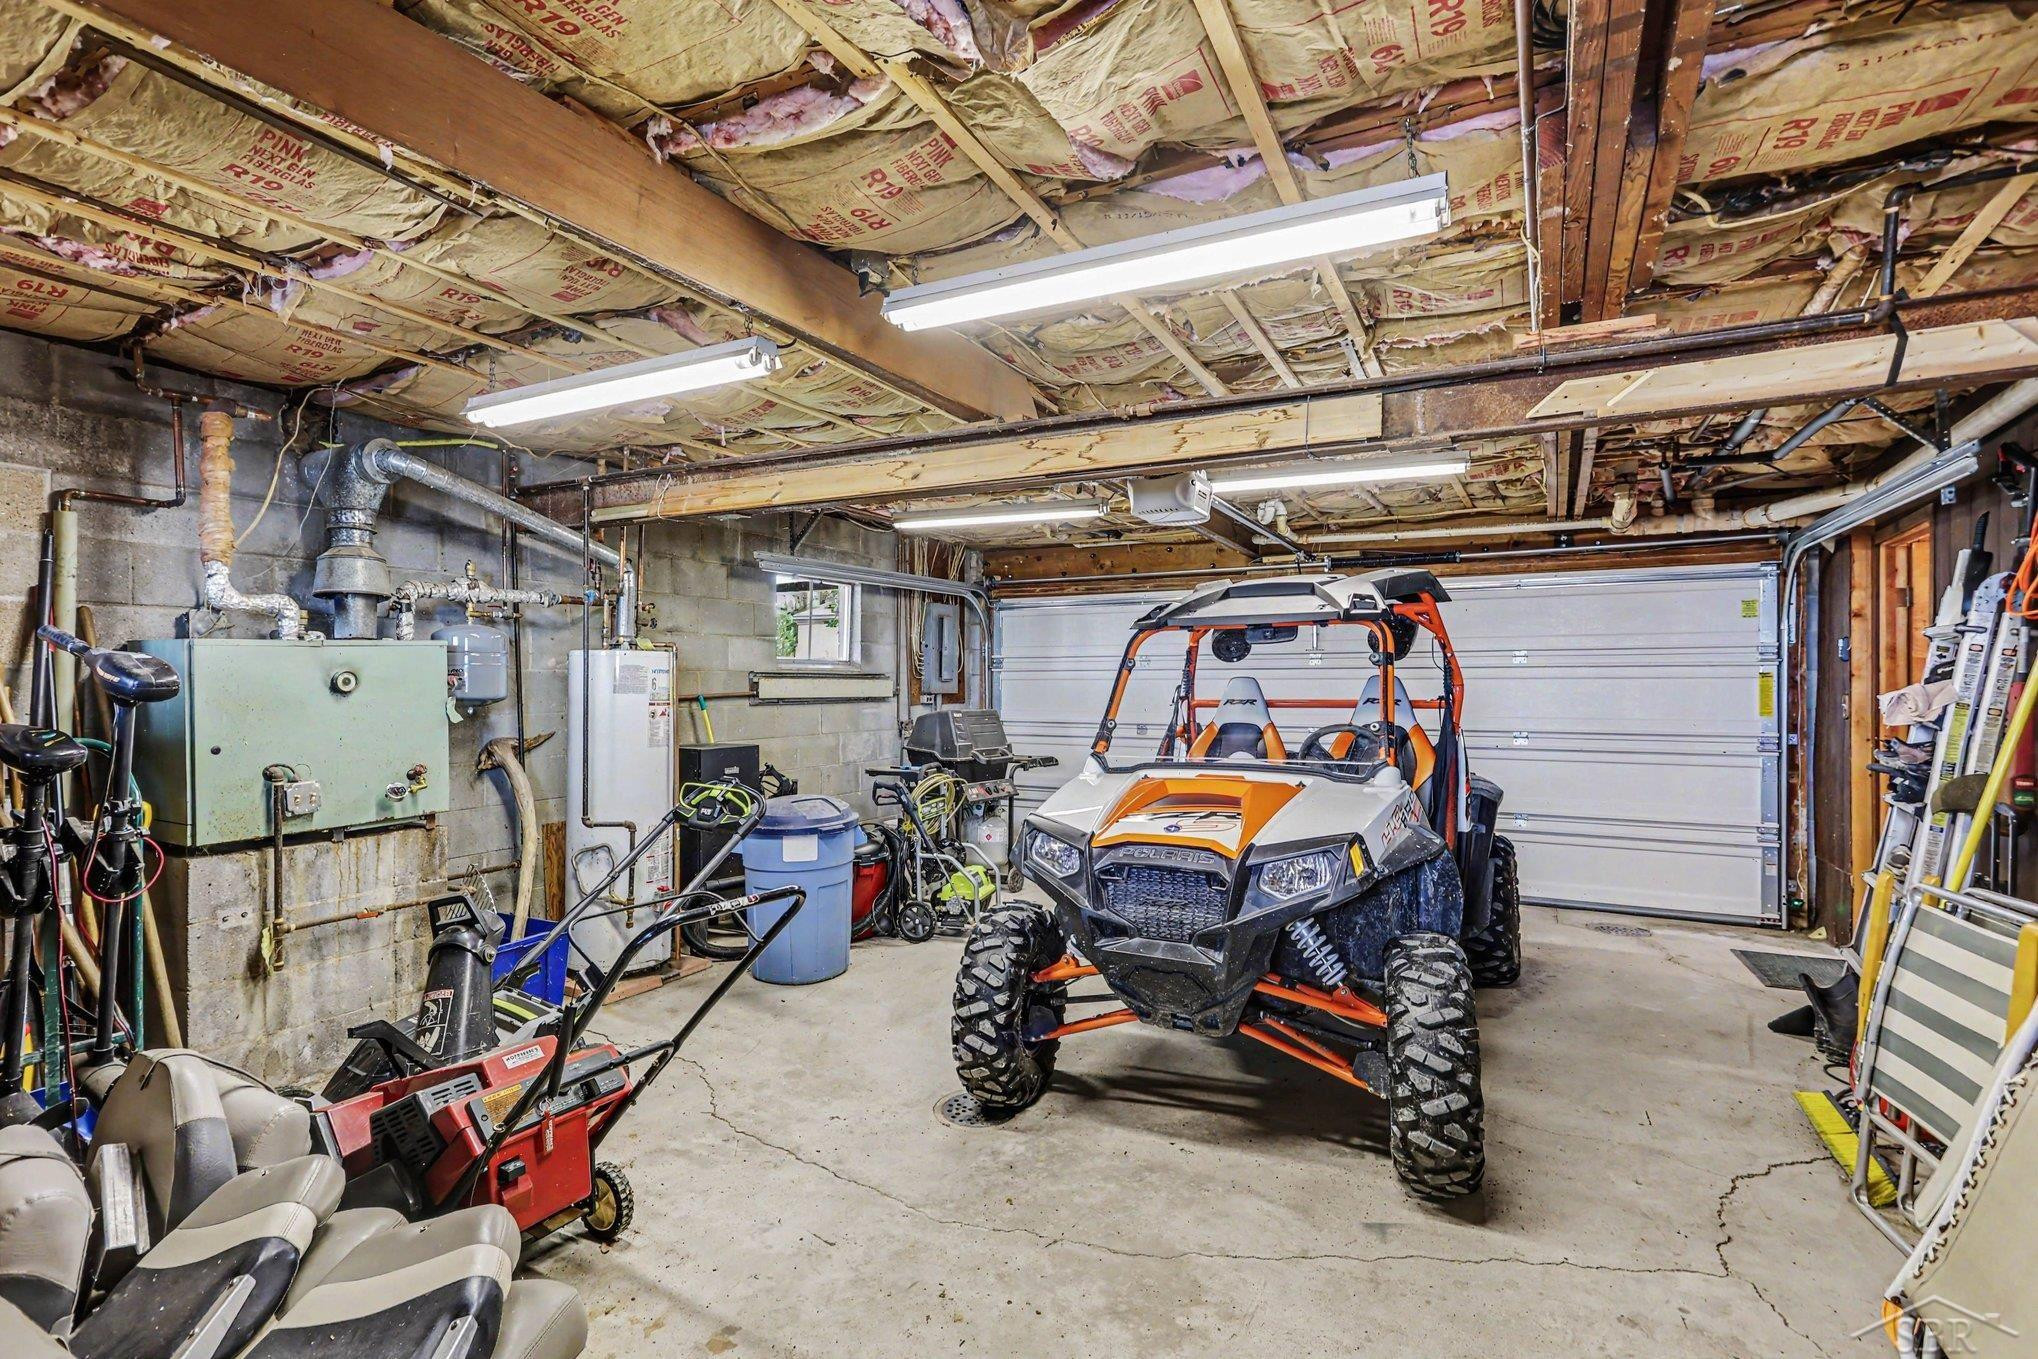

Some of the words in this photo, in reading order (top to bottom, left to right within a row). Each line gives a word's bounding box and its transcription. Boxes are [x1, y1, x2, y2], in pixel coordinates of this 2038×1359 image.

[595, 4, 629, 26] GEN
[1137, 86, 1168, 118] PINK
[258, 128, 310, 163] PINK
[1773, 117, 1819, 150] R19
[250, 143, 285, 167] NEXT
[286, 162, 316, 179] GEN
[905, 150, 931, 171] NEXT
[923, 169, 946, 184] GEN
[920, 137, 954, 169] PINK
[220, 163, 284, 191] R19
[239, 154, 316, 189] FIBERGLAS
[860, 168, 904, 200] R19
[851, 207, 893, 231] R19
[16, 279, 69, 299] R19
[438, 287, 482, 305] R19
[7, 299, 47, 313] PINK
[283, 344, 324, 358] R19
[1362, 697, 1402, 706] RR
[1119, 847, 1216, 864] POLARIS
